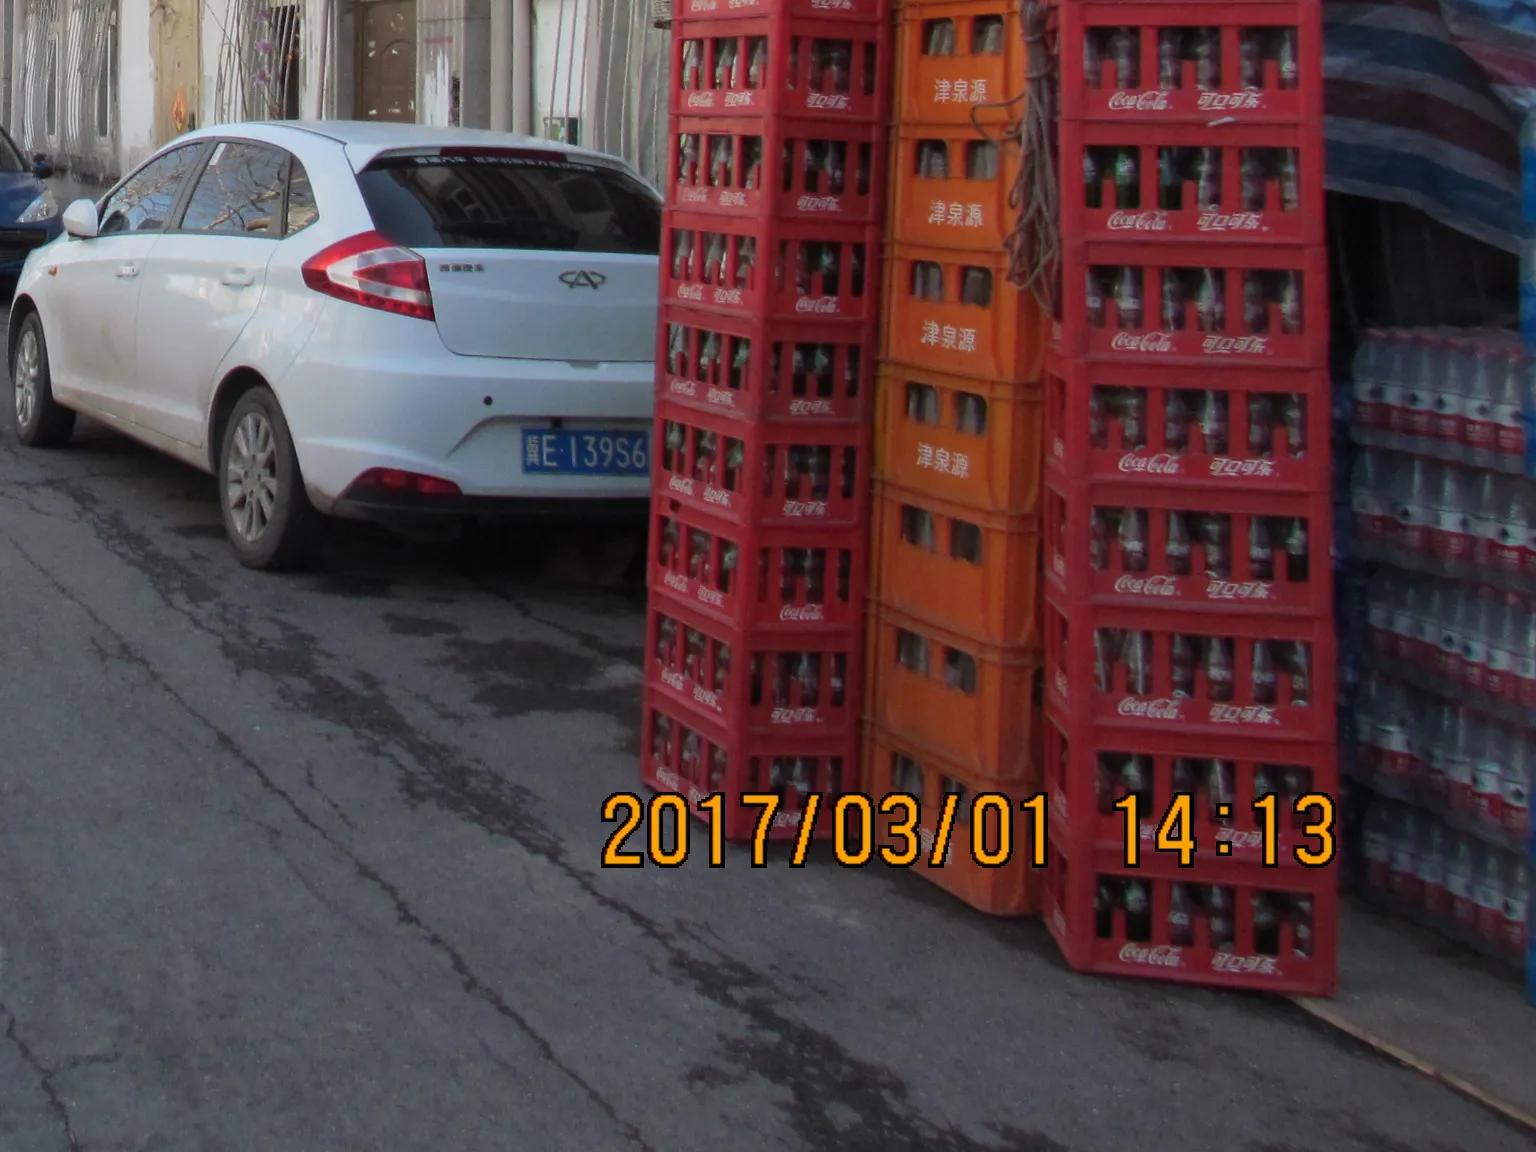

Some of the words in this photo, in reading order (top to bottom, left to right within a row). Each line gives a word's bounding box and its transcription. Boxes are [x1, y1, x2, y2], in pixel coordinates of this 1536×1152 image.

[934, 78, 986, 103] 津泉源
[1197, 92, 1262, 110] 可口可乐
[928, 200, 984, 228] 津泉源
[1197, 212, 1262, 231] 可口可乐
[921, 320, 976, 352] 津泉源
[1202, 335, 1268, 354] 可口可乐
[916, 442, 969, 478] 津泉源
[1210, 457, 1274, 476] 可口可乐
[1206, 580, 1270, 599] 可口可乐
[1209, 704, 1273, 724] 可口可乐
[1212, 952, 1276, 974] 可口可乐
